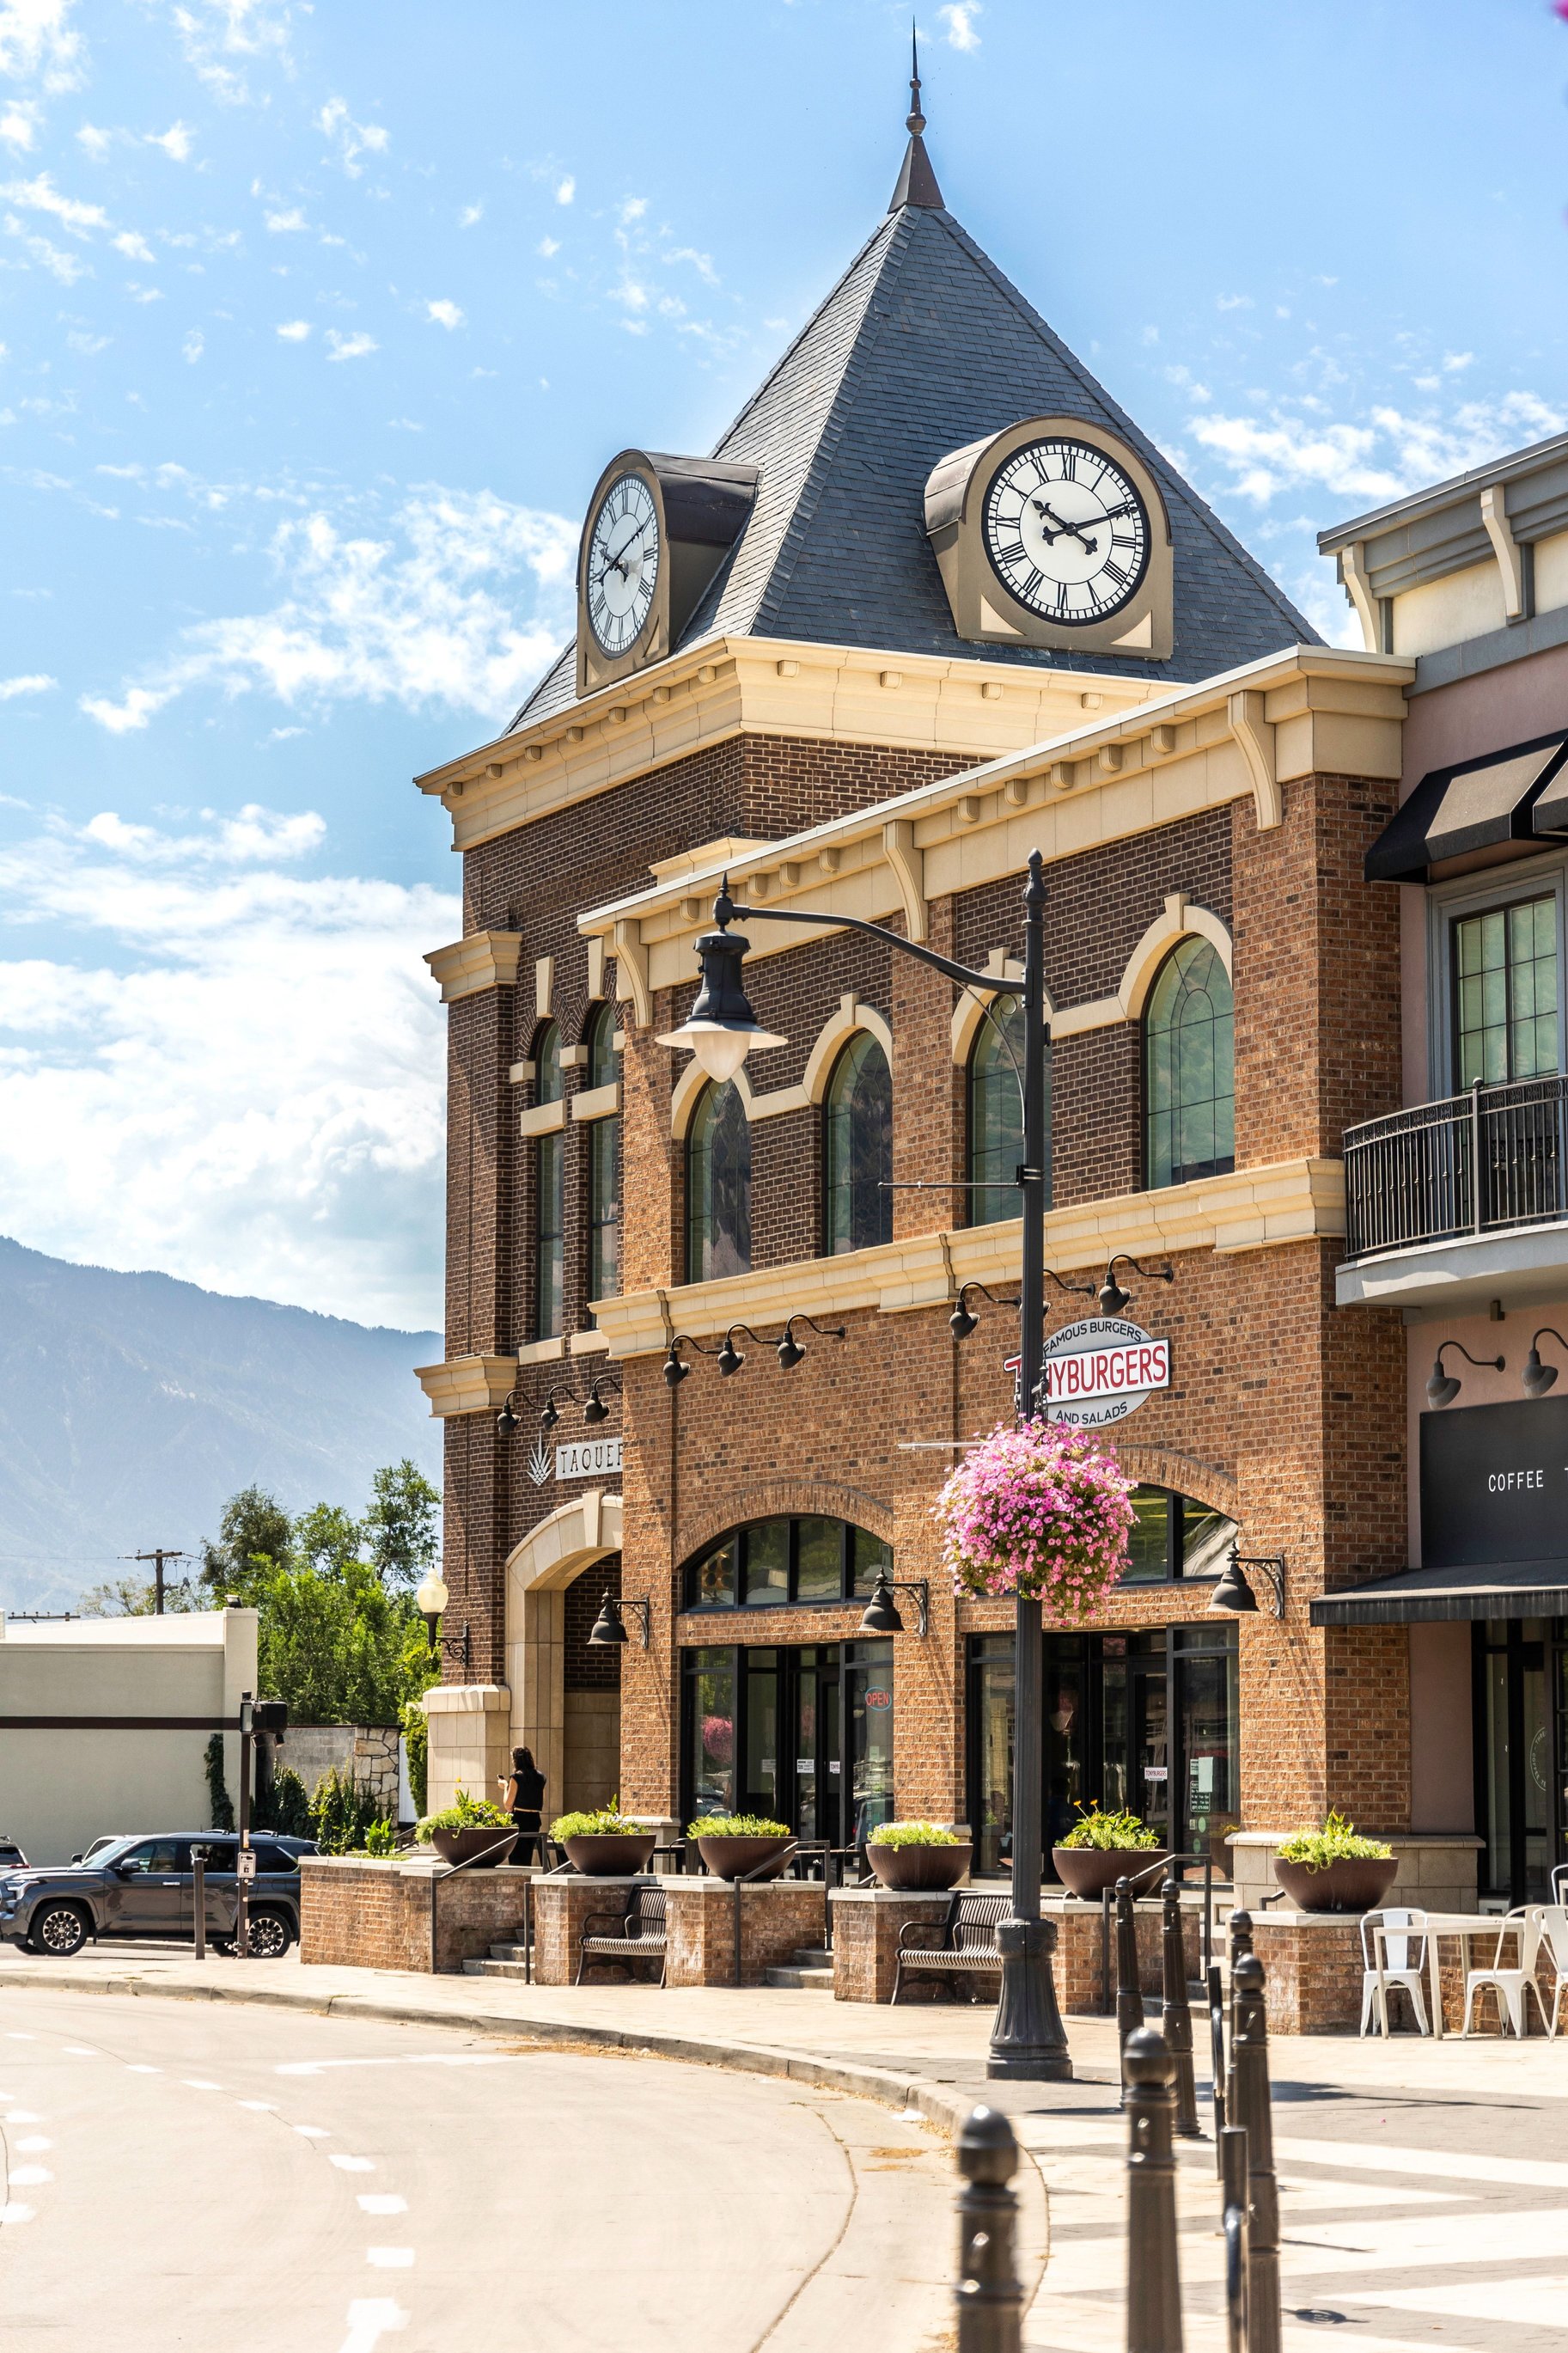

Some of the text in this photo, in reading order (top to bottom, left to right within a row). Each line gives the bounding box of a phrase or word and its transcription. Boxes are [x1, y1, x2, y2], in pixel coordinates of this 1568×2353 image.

[1030, 456, 1049, 485] XI
[1060, 454, 1076, 481] XII
[1006, 480, 1029, 502] X
[996, 514, 1020, 529] IX
[1112, 535, 1136, 548] III
[1022, 567, 1045, 597] VII
[1087, 580, 1101, 606] V
[1058, 583, 1068, 609] VI
[1043, 1321, 1142, 1357] FAMOUS BURGERS
[1005, 1345, 1166, 1397] YBURGERS
[1056, 1402, 1128, 1425] AND SALADS
[1488, 1470, 1544, 1492] COFFEE
[866, 1691, 889, 1706] OPEN
